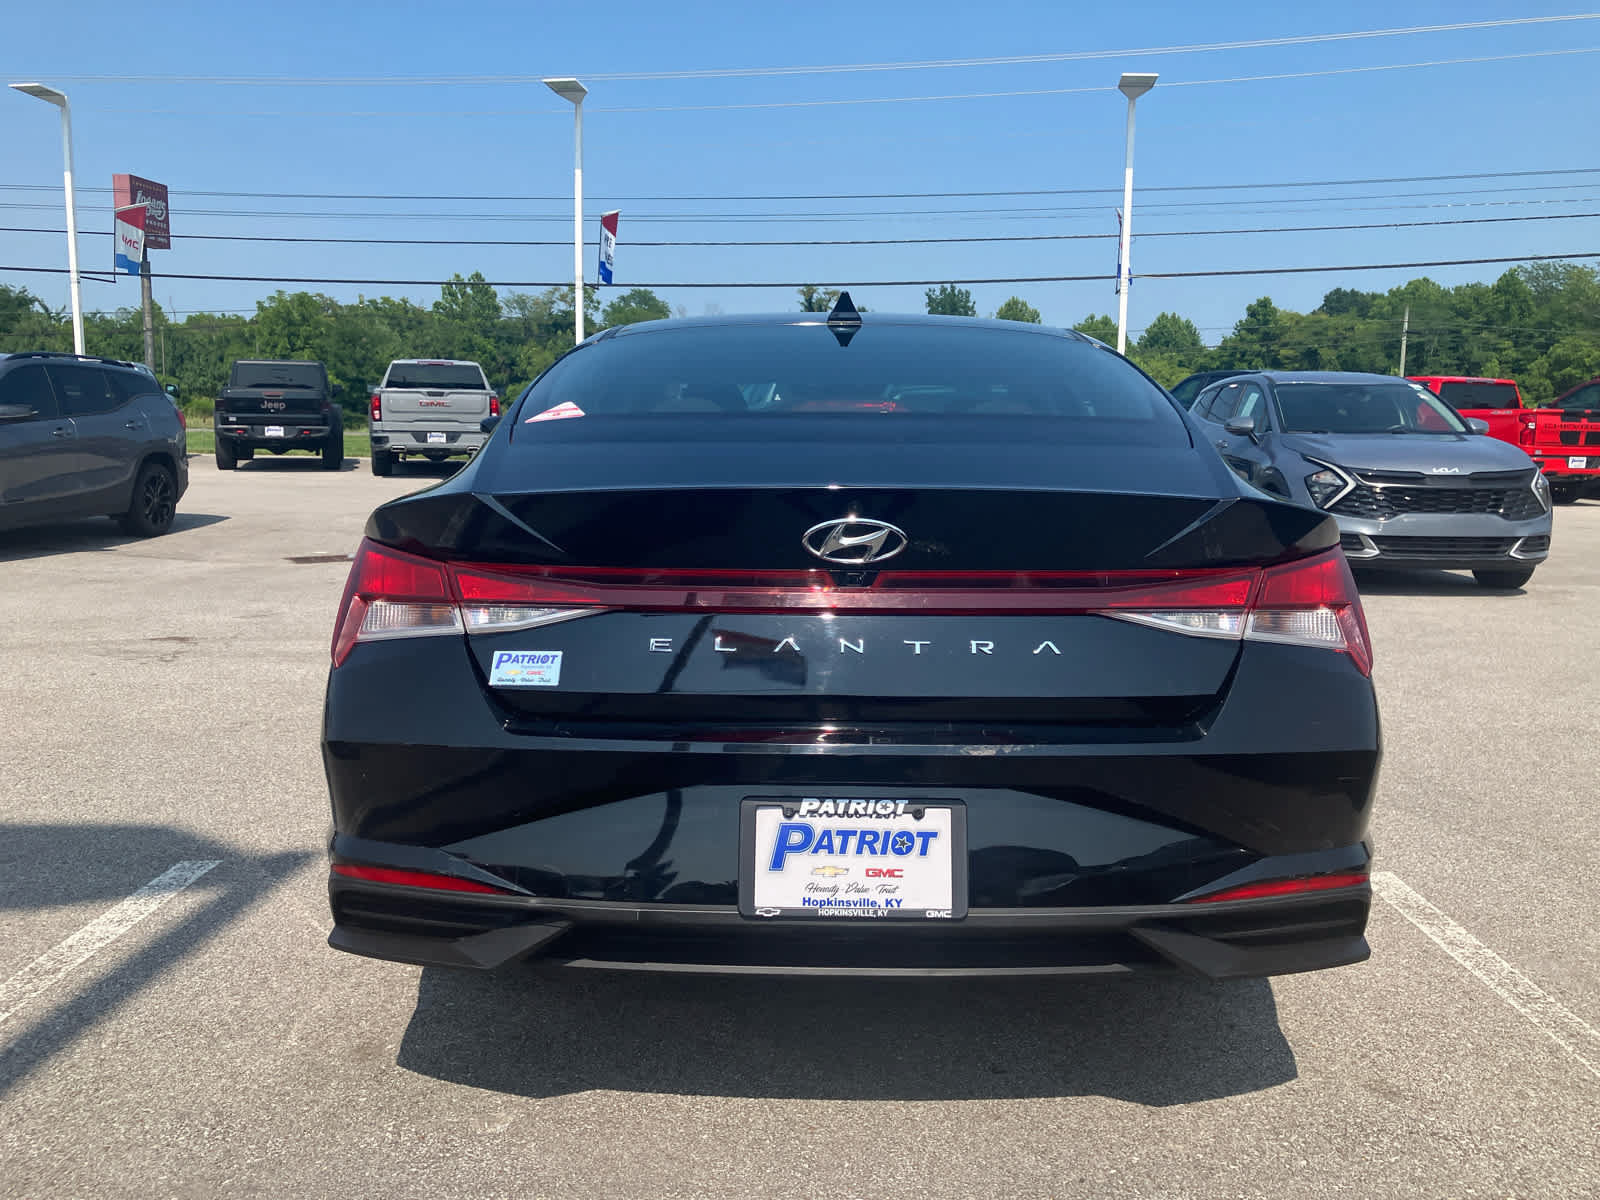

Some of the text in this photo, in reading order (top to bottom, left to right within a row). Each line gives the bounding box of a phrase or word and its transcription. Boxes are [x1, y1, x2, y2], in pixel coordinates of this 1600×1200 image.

[260, 400, 286, 410] Jeep
[648, 637, 1062, 655] ELANTRA
[495, 652, 559, 669] PATRIOT
[799, 798, 909, 816] PATRIOT
[769, 823, 938, 871] PATRIOT
[865, 868, 904, 878] GMC
[875, 884, 899, 894] Trust
[802, 897, 903, 908] Hopkinsville, KY
[818, 909, 889, 918] HOPKINSVILLE, KY
[926, 910, 952, 918] GMC
